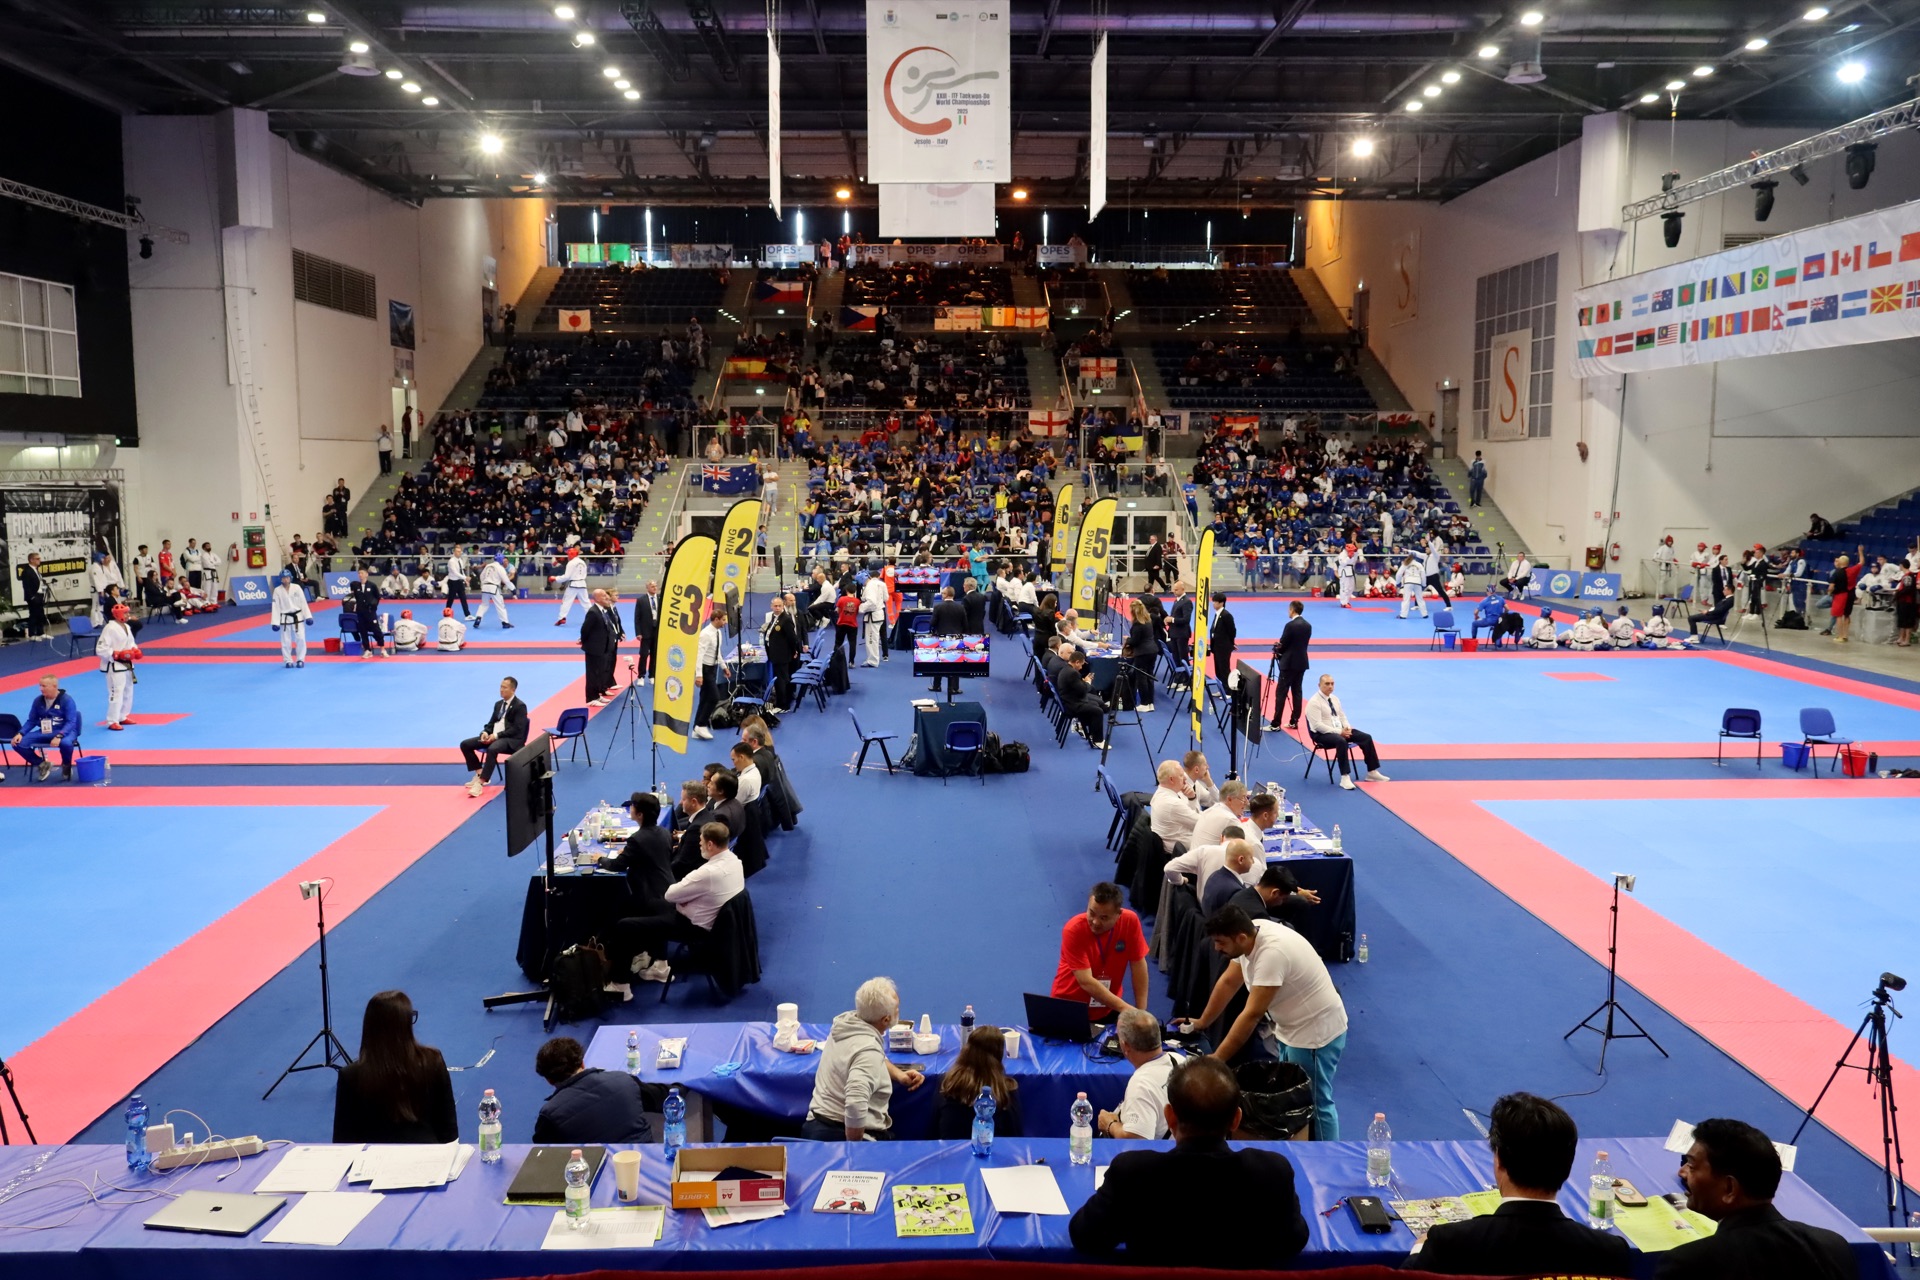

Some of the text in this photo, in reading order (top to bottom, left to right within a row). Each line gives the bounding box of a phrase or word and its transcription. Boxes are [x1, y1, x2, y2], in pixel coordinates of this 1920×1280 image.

[767, 246, 797, 254] OPES
[855, 246, 884, 254] OPES
[907, 246, 936, 255] OPES
[958, 246, 988, 254] OPES
[1041, 246, 1070, 255] OPES
[1091, 378, 1104, 388] WC
[1061, 504, 1069, 524] 6
[13, 511, 84, 535] FITSPORT ITALIA
[725, 528, 752, 557] RING 2
[1083, 528, 1109, 559] RING 5
[238, 590, 267, 600] Daedo
[331, 585, 351, 595] Dae
[1584, 585, 1614, 596] Daedo
[1202, 577, 1209, 626] 4
[667, 584, 703, 635] RING 3
